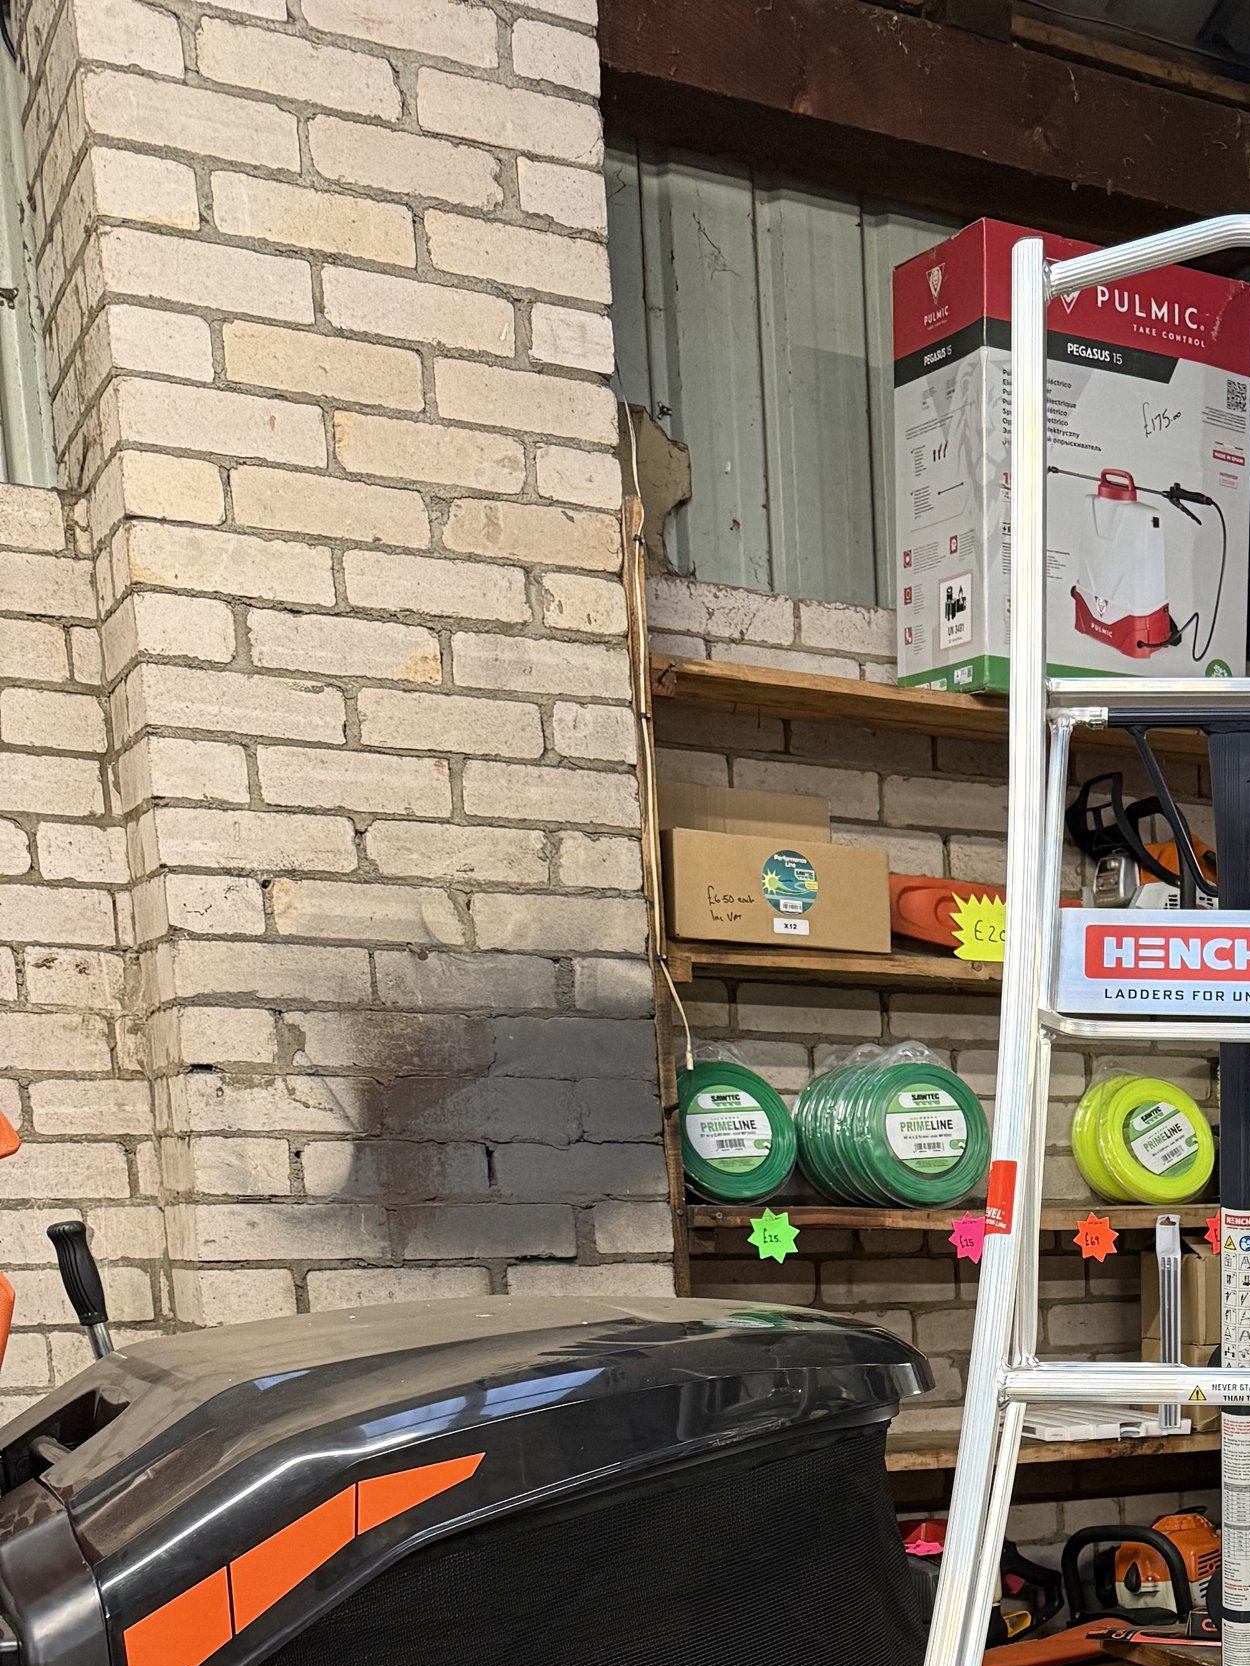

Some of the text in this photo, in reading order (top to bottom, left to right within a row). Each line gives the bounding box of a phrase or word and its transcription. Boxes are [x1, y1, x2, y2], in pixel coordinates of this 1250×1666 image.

[923, 305, 950, 326] PULMIC
[1097, 286, 1198, 329] PULMIC
[1133, 324, 1206, 348] TAKE CONTROL
[923, 347, 946, 367] PEGASUS
[1067, 343, 1123, 365] PEGASUS 15
[1104, 988, 1185, 1001] LADDERS
[1193, 990, 1226, 1002] FOR
[711, 1094, 741, 1102] SAWTEC
[911, 1093, 940, 1101] SAWTEC
[700, 1120, 757, 1133] PRIMELINE
[899, 1119, 954, 1132] PRIMELINE
[1143, 1123, 1183, 1153] PRIMELINE
[1212, 1383, 1236, 1391] NEVER
